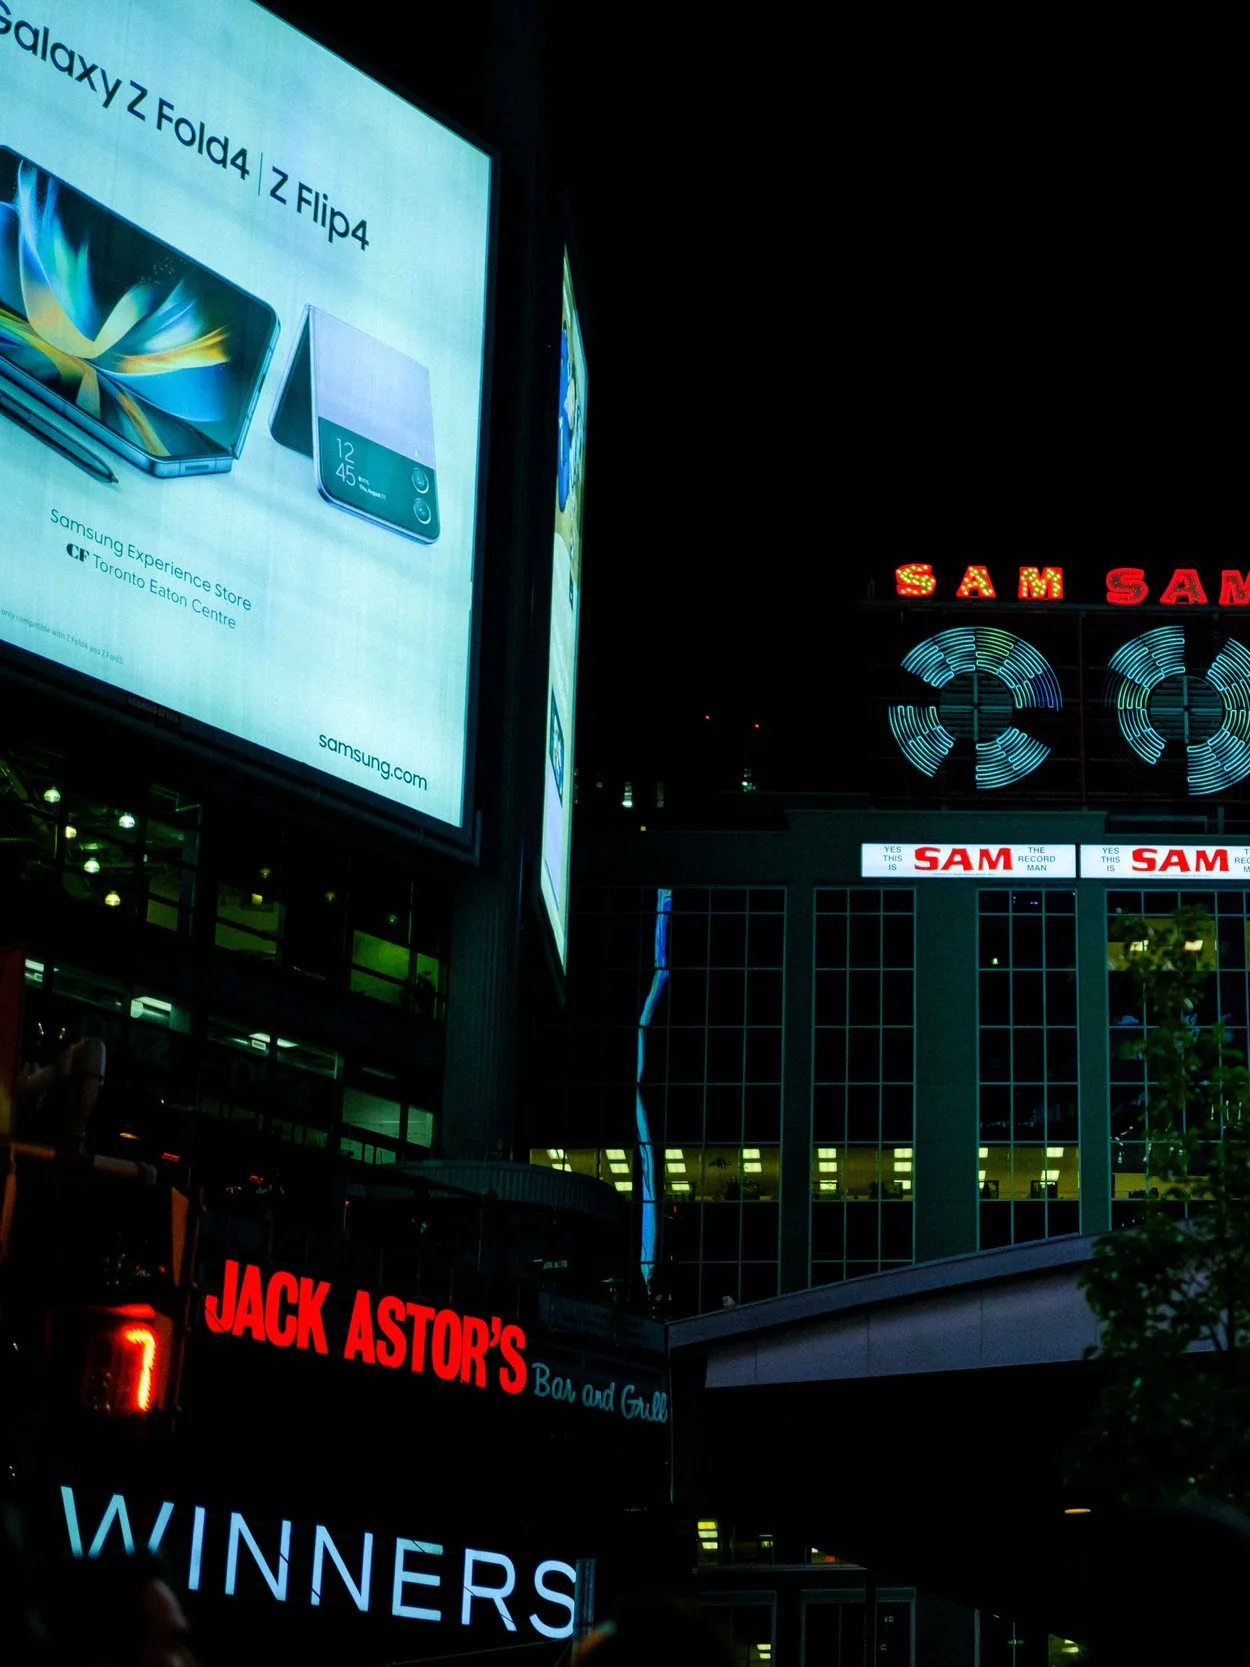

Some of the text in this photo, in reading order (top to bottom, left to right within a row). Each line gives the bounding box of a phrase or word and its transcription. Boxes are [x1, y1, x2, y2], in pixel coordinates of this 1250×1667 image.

[127, 80, 149, 121] Z
[157, 97, 250, 181] Fold4
[269, 166, 290, 205] Z
[296, 180, 370, 251] Flip4
[336, 438, 355, 464] 12
[335, 462, 356, 487] 45
[50, 508, 252, 611] Samsung Experience Store
[66, 542, 236, 630] CF Toronto Eaton Centre
[896, 563, 1064, 600] SAM
[318, 732, 429, 791] samsung.com
[883, 855, 903, 863] THIS
[884, 846, 902, 854] YES
[914, 847, 1013, 871] SAM
[1017, 855, 1056, 863] RECORD
[1027, 846, 1046, 854] THE
[1101, 856, 1121, 864] THIS
[1102, 847, 1120, 855] YES
[1131, 847, 1230, 872] SAM
[1027, 864, 1047, 872] MAN
[205, 1258, 527, 1395] JACK ASTOR'S
[532, 1362, 667, 1423] Bar and Grill
[60, 1485, 577, 1639] WINNERS
